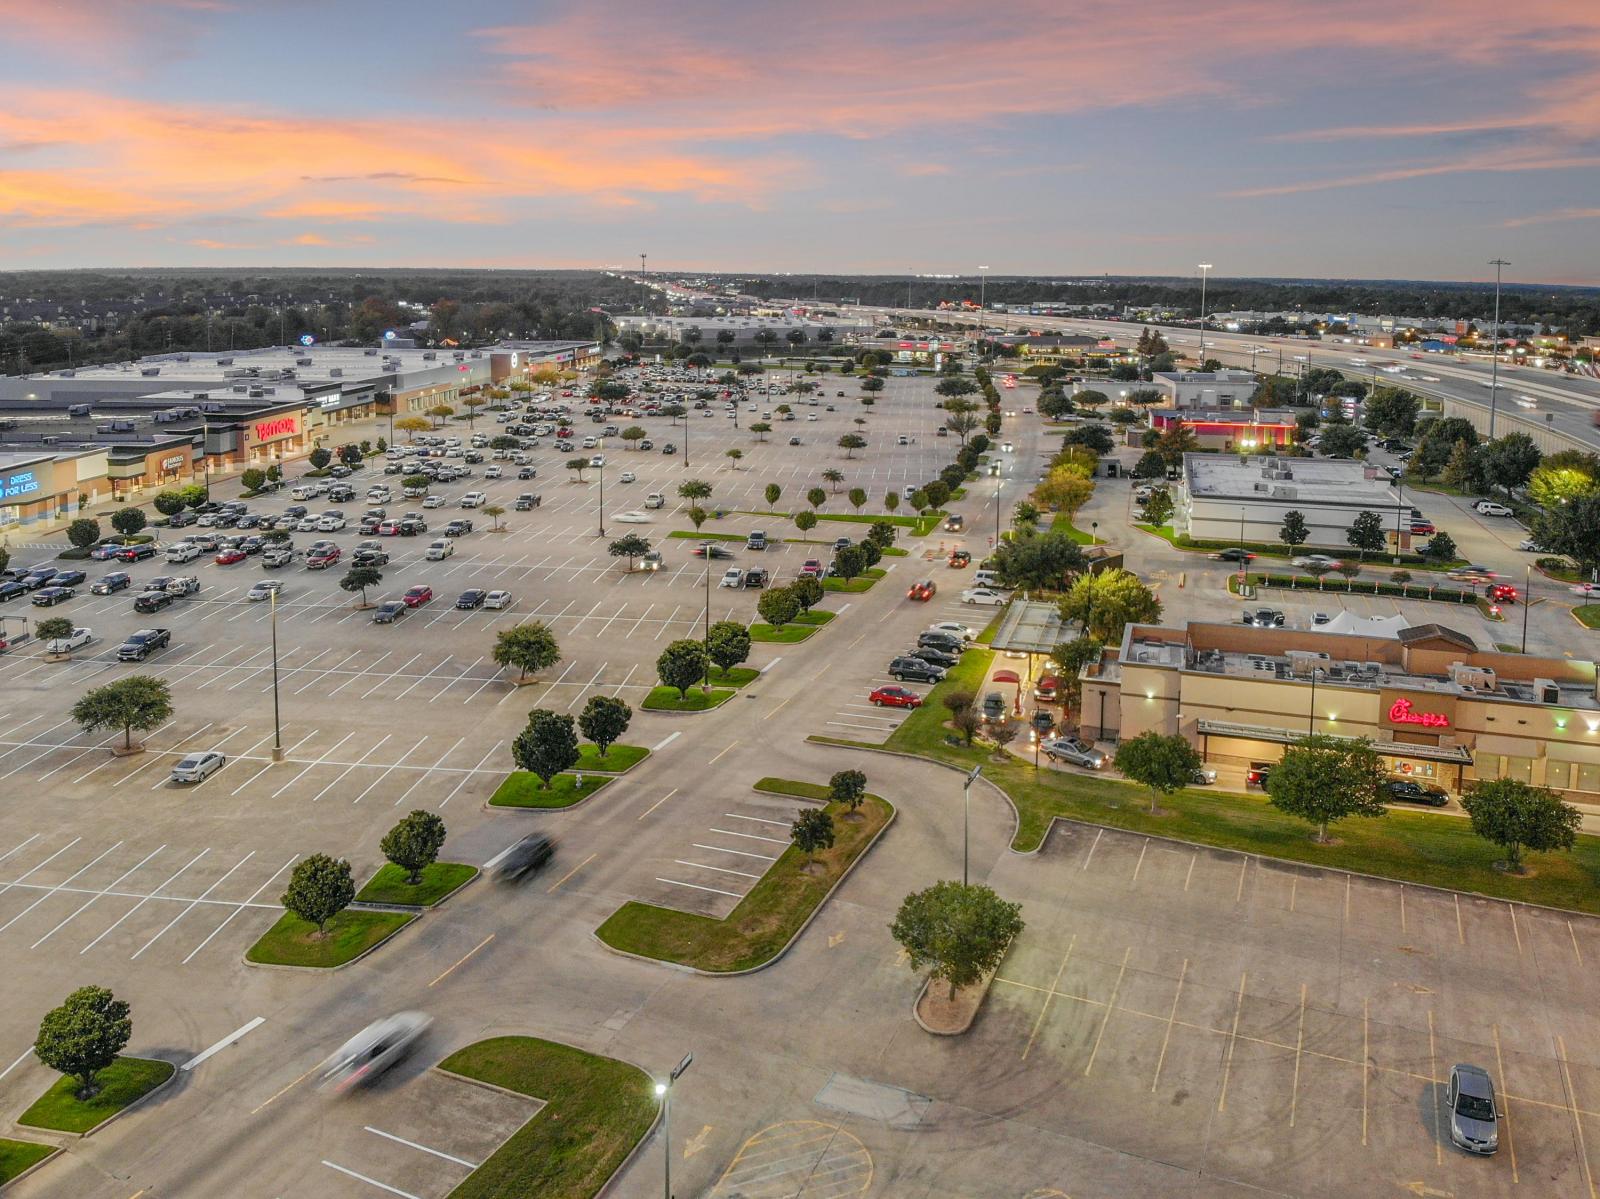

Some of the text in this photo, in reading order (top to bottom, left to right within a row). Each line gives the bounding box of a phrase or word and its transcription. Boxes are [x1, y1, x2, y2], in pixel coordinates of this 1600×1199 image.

[10, 473, 32, 485] DRESS
[5, 486, 19, 497] FOR
[21, 481, 38, 493] LESS
